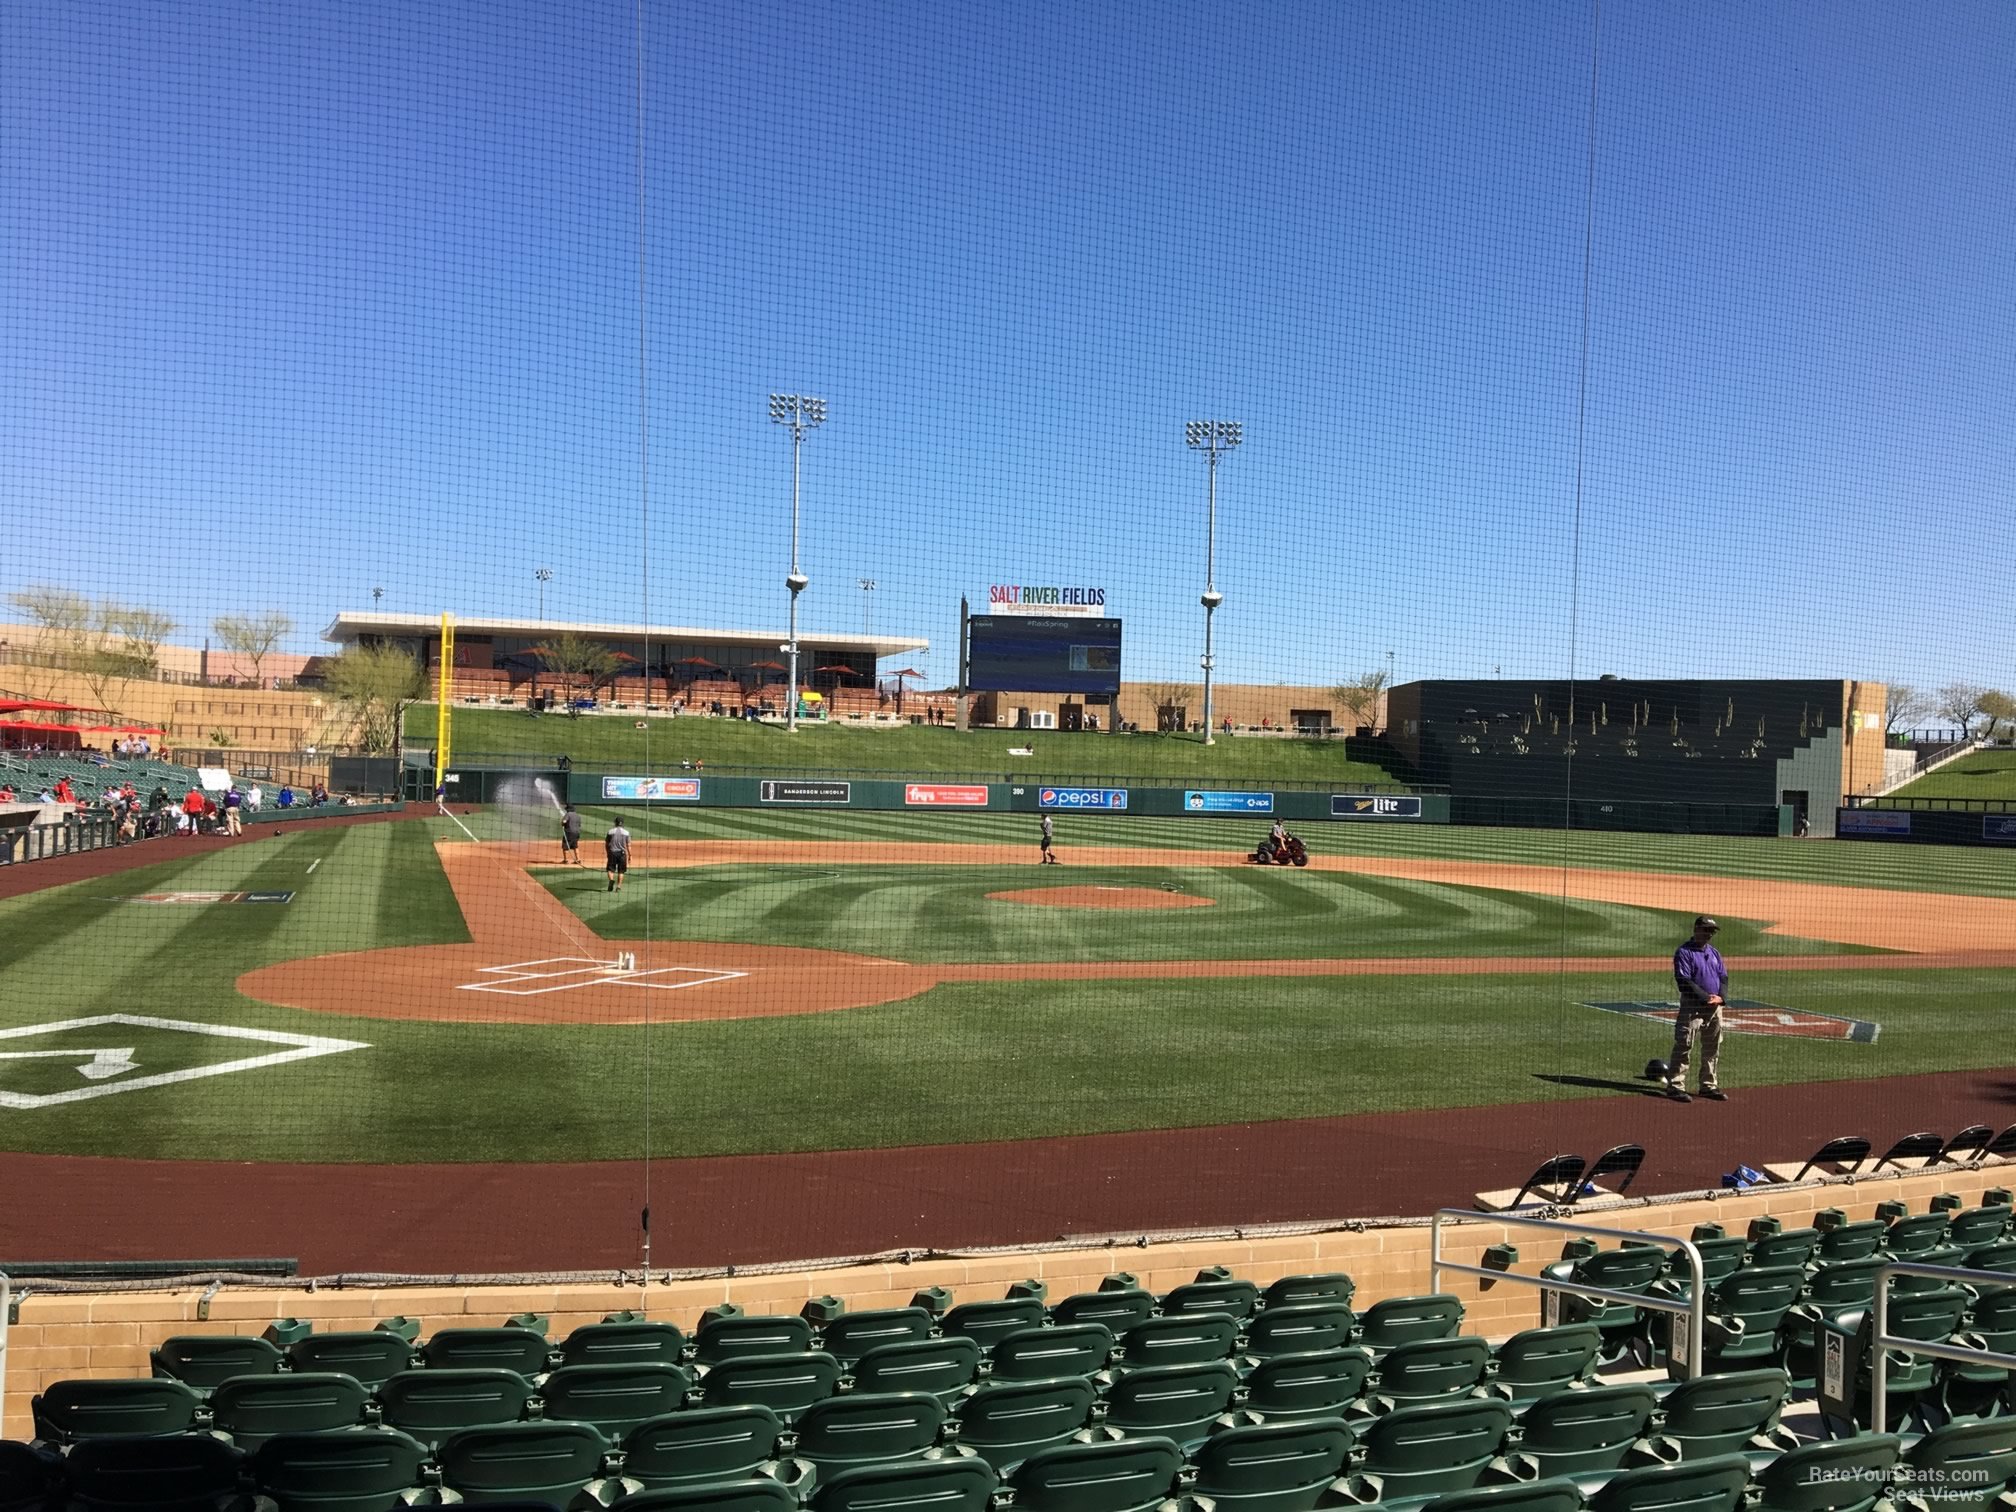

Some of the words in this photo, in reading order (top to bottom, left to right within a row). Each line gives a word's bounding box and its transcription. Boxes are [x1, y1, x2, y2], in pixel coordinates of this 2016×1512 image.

[990, 585, 1020, 603] SALT
[1023, 586, 1059, 604] RIVER
[1062, 587, 1105, 605] FIELDS
[445, 773, 460, 783] 345
[1012, 787, 1025, 795] 390
[1058, 791, 1104, 807] pepsi
[1373, 798, 1398, 813] Lite
[1600, 805, 1613, 813] 410
[1829, 1384, 1836, 1394] 3
